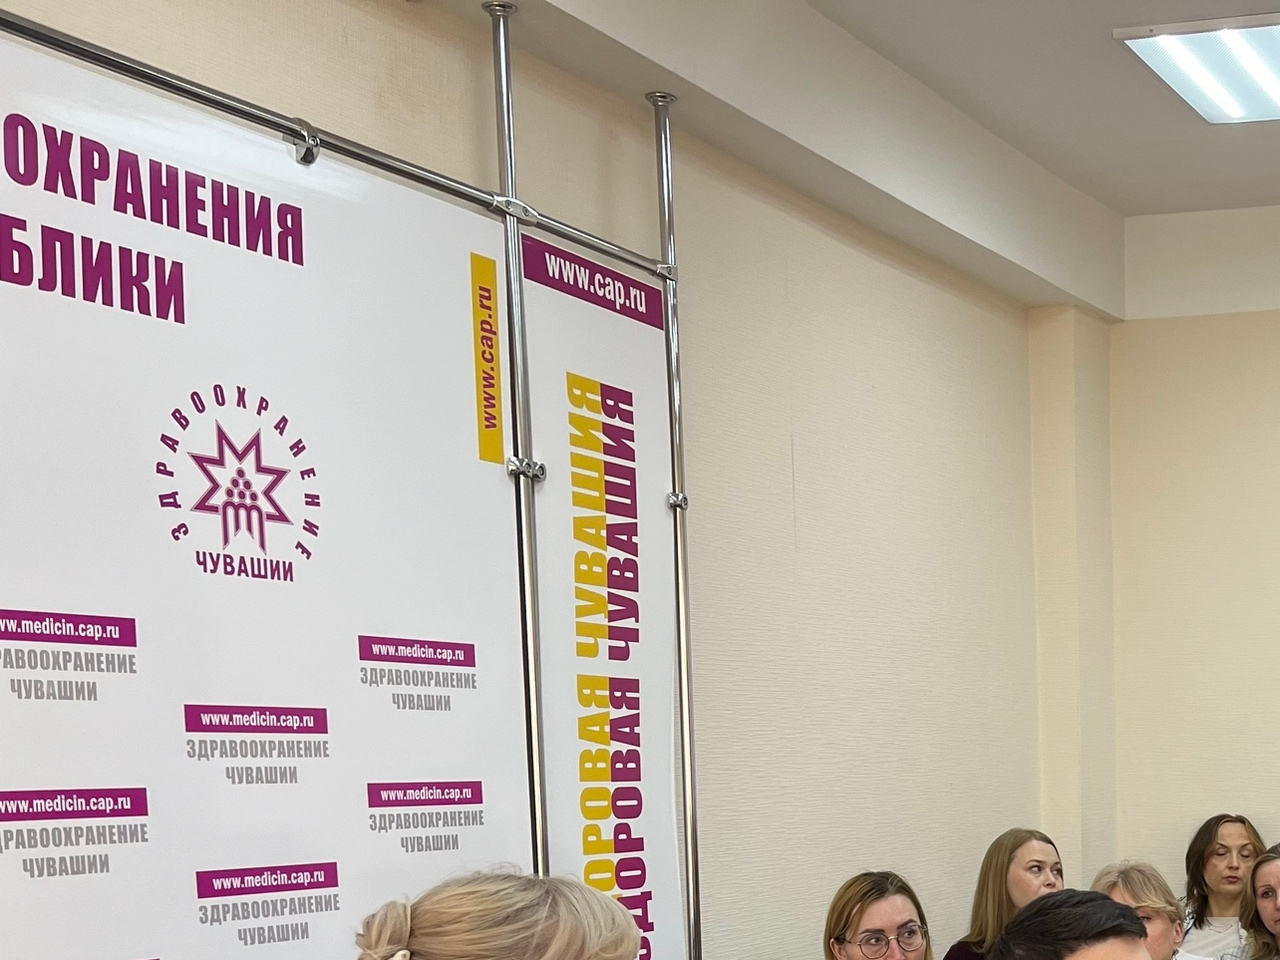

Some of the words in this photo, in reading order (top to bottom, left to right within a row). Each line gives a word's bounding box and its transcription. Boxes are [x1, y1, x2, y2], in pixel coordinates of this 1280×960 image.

[4, 113, 305, 267] ОХРАНЕНИЯ
[0, 213, 186, 325] БЛИКИ
[544, 251, 647, 314] www.cap.ru
[478, 285, 498, 431] www.cap.ru
[156, 384, 321, 560] ЗДРАВООХРАНЕНИЕ
[566, 371, 609, 658] ЧУВАШИЯ
[600, 382, 640, 662] ЧУВАШИЯ
[195, 550, 294, 582] ЧУВАШИИ
[0, 648, 137, 674] АВООХРАНЕНИЕ
[371, 643, 465, 662] www.medicin.cap.ru
[10, 679, 98, 701] ЧУВАШИИ
[360, 667, 477, 689] ЗДРАВООХРАНЕНИЕ
[392, 693, 451, 711] ЧУВАШИИ
[200, 710, 314, 730] www.medicin.cap.ru
[186, 739, 330, 761] ЗДРАВООХРАНЕНИЕ
[225, 766, 298, 785] ЧУВАШИИ
[380, 786, 472, 802] www.medicin.cap.ru
[577, 674, 622, 902] ОРОВАЯ
[369, 810, 484, 833] ЗДРАВООХРАНЕНИЕ
[0, 823, 149, 854] РАВООХРАНЕНИЕ
[401, 834, 459, 853] ЧУВАШИИ
[22, 854, 110, 878] ЧУВАШИИ
[212, 870, 325, 890] www.medicin.cap.ru
[198, 894, 340, 926] ЗДРАВООХРАНЕНИЕ
[238, 922, 309, 946] ЧУВАШИИ
